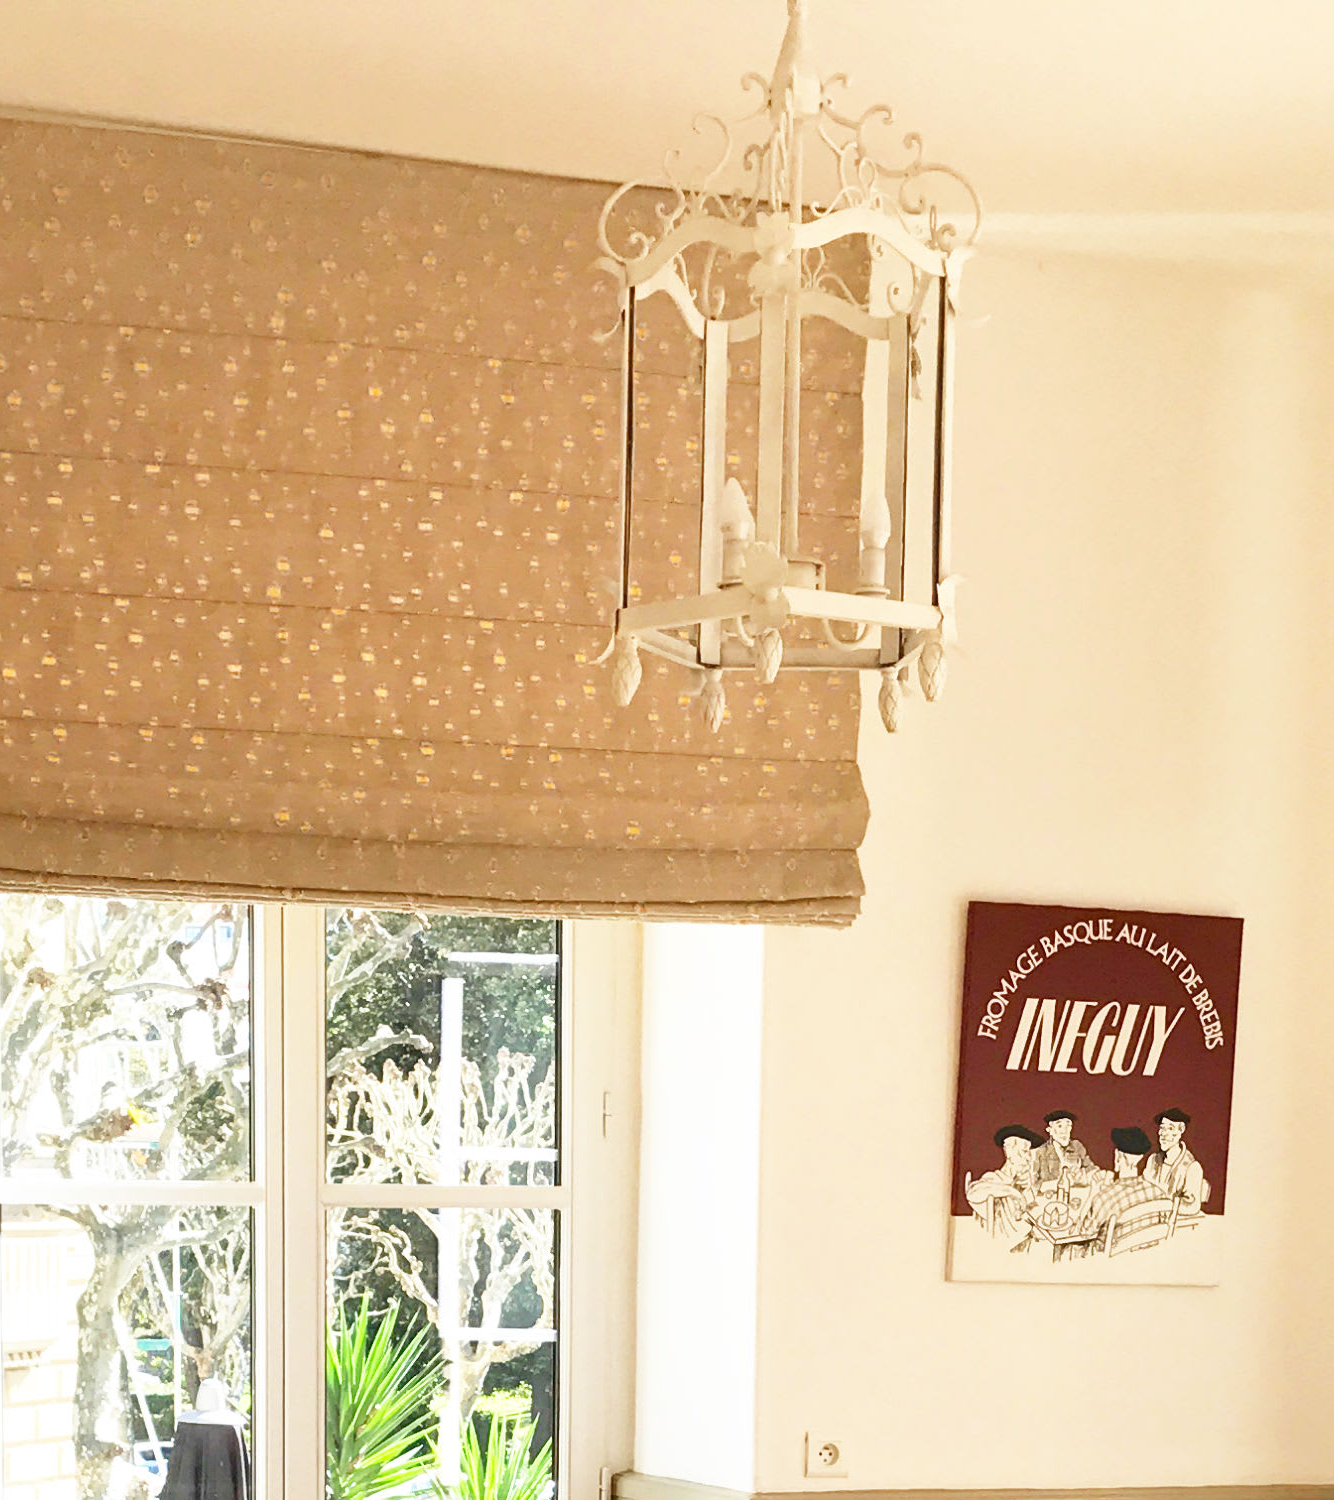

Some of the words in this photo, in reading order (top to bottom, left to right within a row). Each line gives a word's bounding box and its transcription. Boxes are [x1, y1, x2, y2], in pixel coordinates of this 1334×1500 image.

[977, 944, 1044, 1041] FROMAGE
[1039, 917, 1115, 957] BASQUE
[1115, 922, 1148, 948] AU
[1146, 932, 1188, 972] LAIT
[1178, 963, 1204, 995] DE
[1192, 987, 1225, 1051] BREBIS
[1005, 997, 1186, 1077] INEGUY
